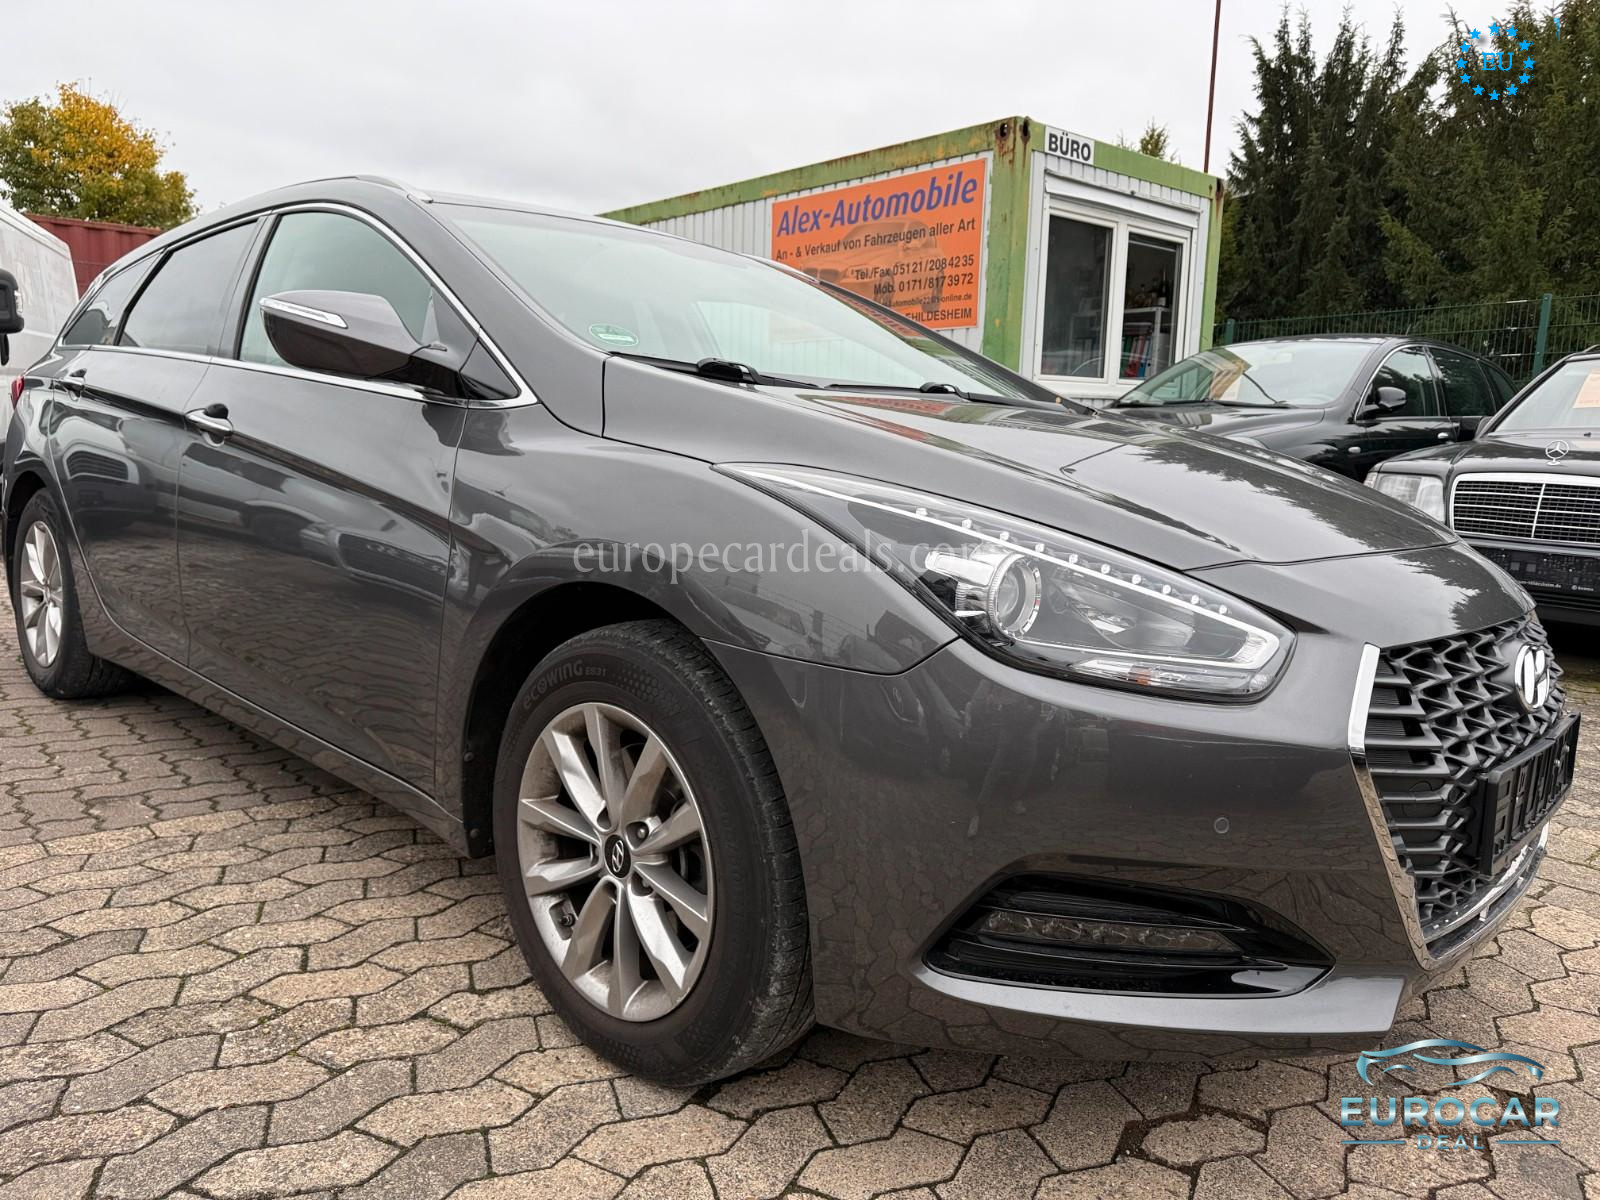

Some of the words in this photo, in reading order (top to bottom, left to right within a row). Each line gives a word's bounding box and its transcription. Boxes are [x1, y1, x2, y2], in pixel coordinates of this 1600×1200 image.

[1048, 131, 1091, 162] BÜRO
[776, 170, 978, 238] Alex-Automobile
[804, 240, 841, 257] Verkauf
[842, 238, 862, 250] von
[864, 227, 926, 247] Fahrzeugen
[928, 221, 955, 237] aller
[957, 217, 976, 233] Art
[873, 283, 896, 295] Mob.
